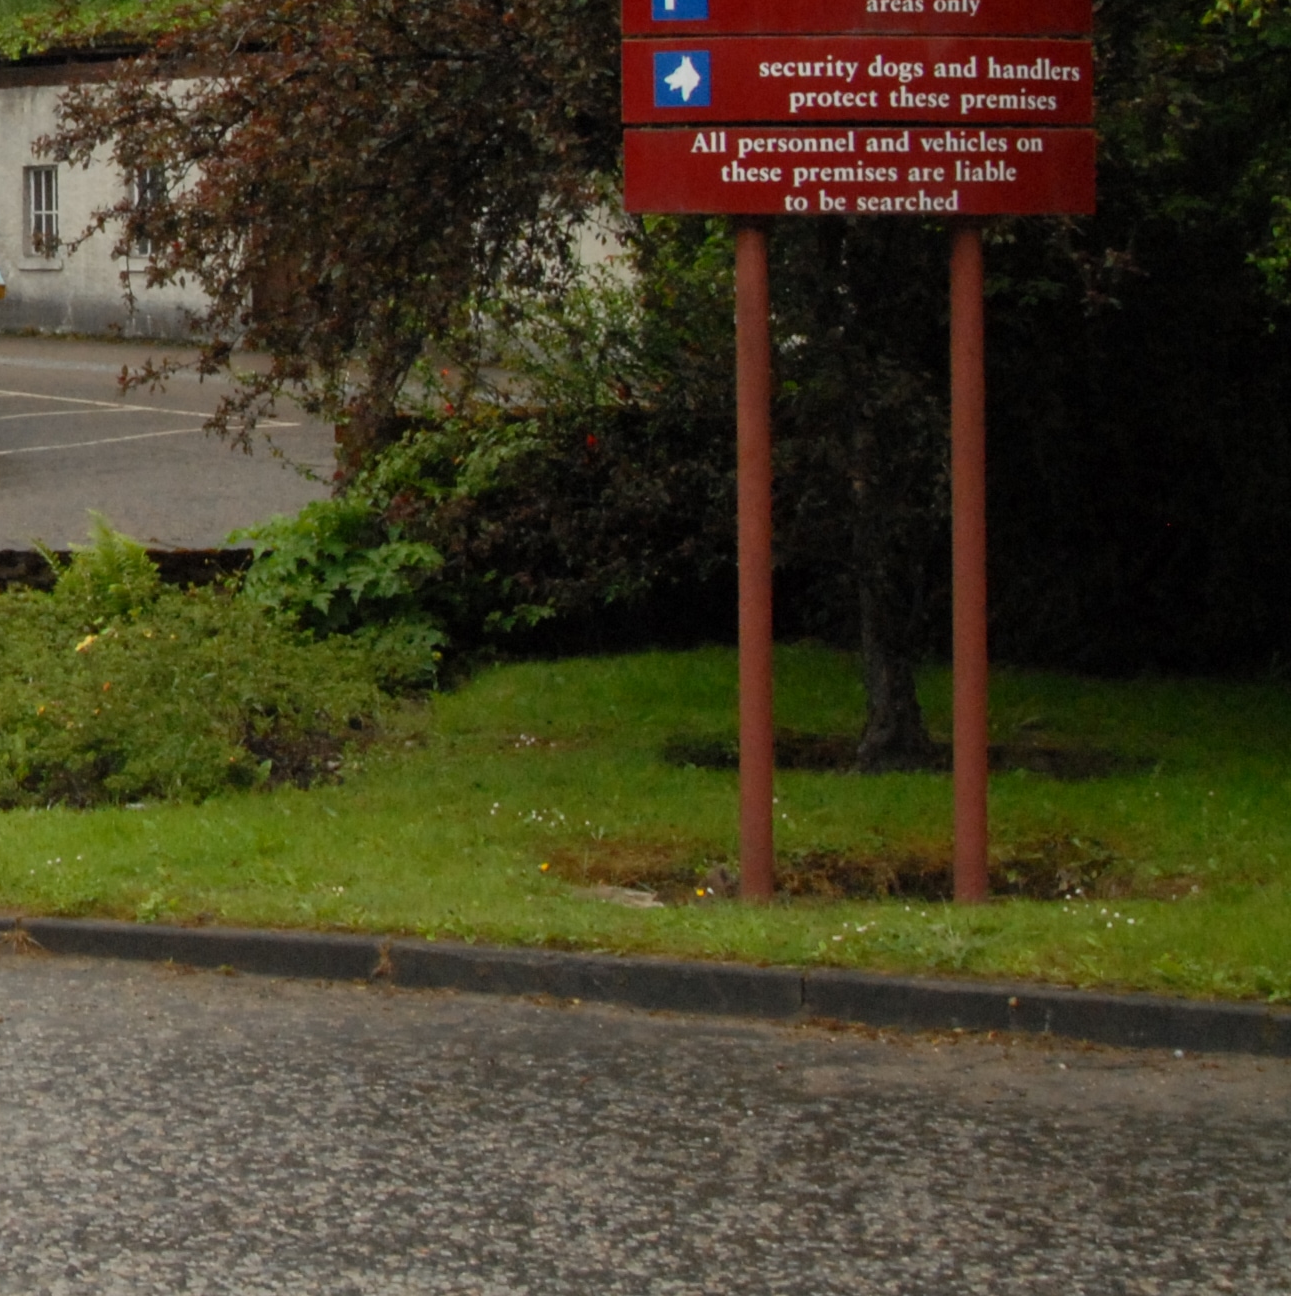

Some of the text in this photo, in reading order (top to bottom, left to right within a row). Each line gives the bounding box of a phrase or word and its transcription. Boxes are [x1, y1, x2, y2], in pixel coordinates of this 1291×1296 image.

[758, 54, 1080, 84] security dogs and handlers
[789, 88, 1057, 115] protect these premises
[690, 131, 1043, 158] All personnel and vehicles on
[720, 160, 1017, 188] these premises are liable
[784, 189, 959, 212] to be searched
